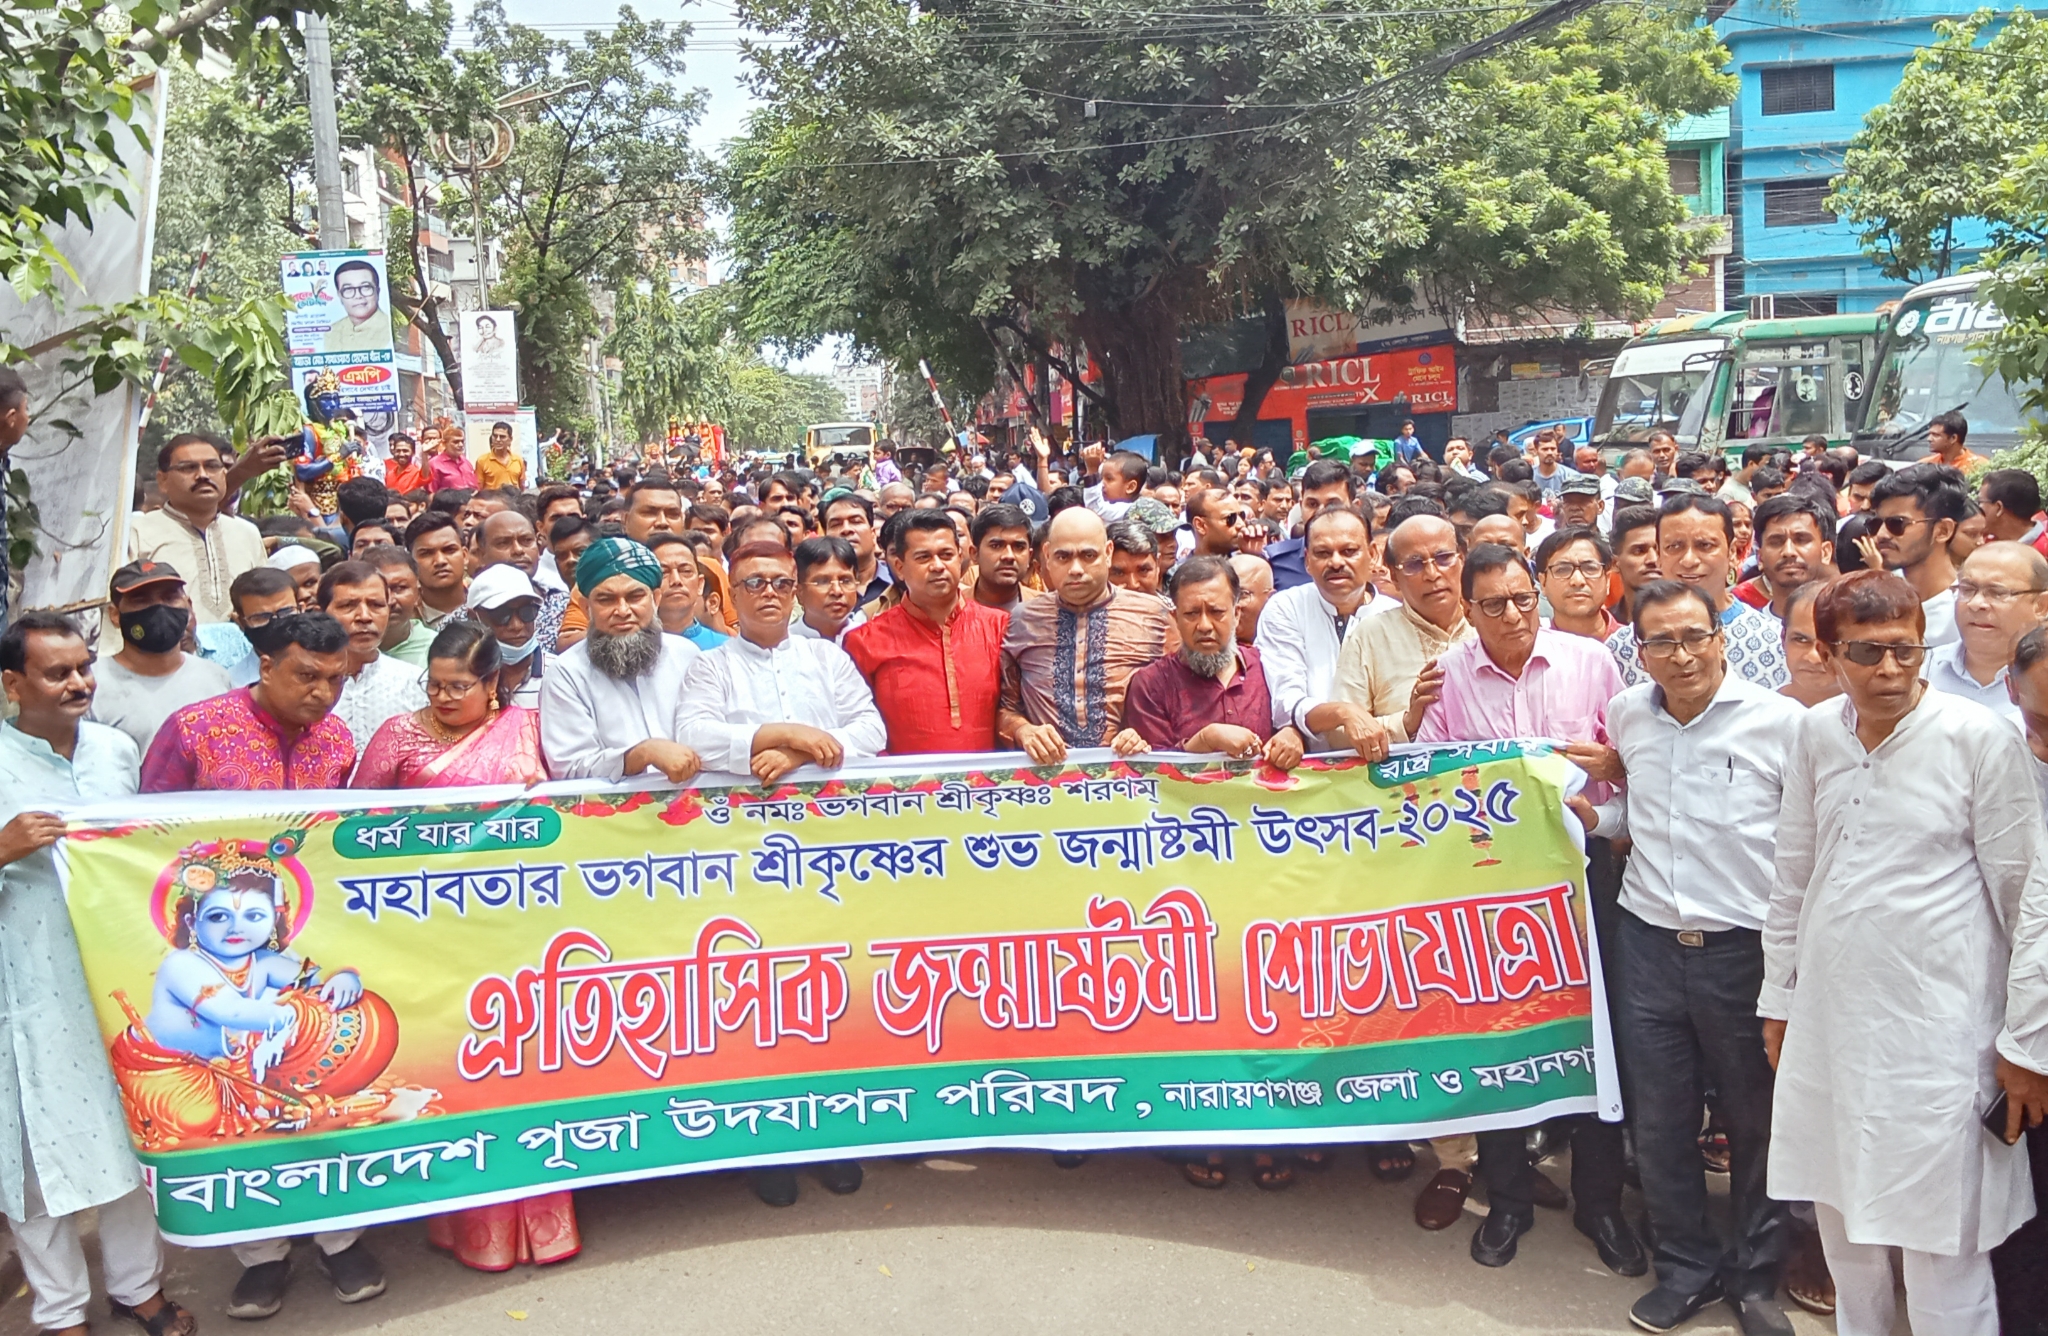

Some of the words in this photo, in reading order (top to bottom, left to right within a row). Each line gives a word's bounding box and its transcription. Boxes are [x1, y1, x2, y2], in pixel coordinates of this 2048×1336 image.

[1290, 313, 1350, 338] RICL
[343, 368, 381, 384] এমপি
[1304, 358, 1380, 387] RICL
[1411, 390, 1449, 404] RICL
[742, 801, 805, 823] নমঃ
[816, 792, 927, 817] ভগবান
[936, 782, 1051, 818] শ্রীকৃষ্ণঃ
[1063, 777, 1159, 804] শরণম্
[338, 862, 566, 921] মহাবতার
[578, 851, 739, 898] ভগবান
[753, 833, 949, 903] শ্রীকৃষ্ণের
[964, 832, 1042, 869] শুভ
[1053, 806, 1239, 872] জন্মাষ্টমী
[1250, 779, 1521, 855] উৎসব-২০২৫
[355, 815, 409, 851] ধর্ম
[414, 819, 474, 847] যার
[483, 815, 543, 843] যার
[458, 916, 850, 1079] ঐতিহাসিক
[868, 886, 1218, 1054] জন্মাষ্টমী
[1242, 880, 1589, 1035] শোভাযাত্রা
[162, 1130, 498, 1213] বাংলাদেশ
[517, 1111, 650, 1170] পূজা
[664, 1087, 917, 1139] উদযাপন
[936, 1069, 1126, 1117] পরিষদ
[1159, 1077, 1322, 1112] নারায়ণগঞ্জ
[1336, 1069, 1420, 1103] জেলা
[1432, 1069, 1463, 1094] ও
